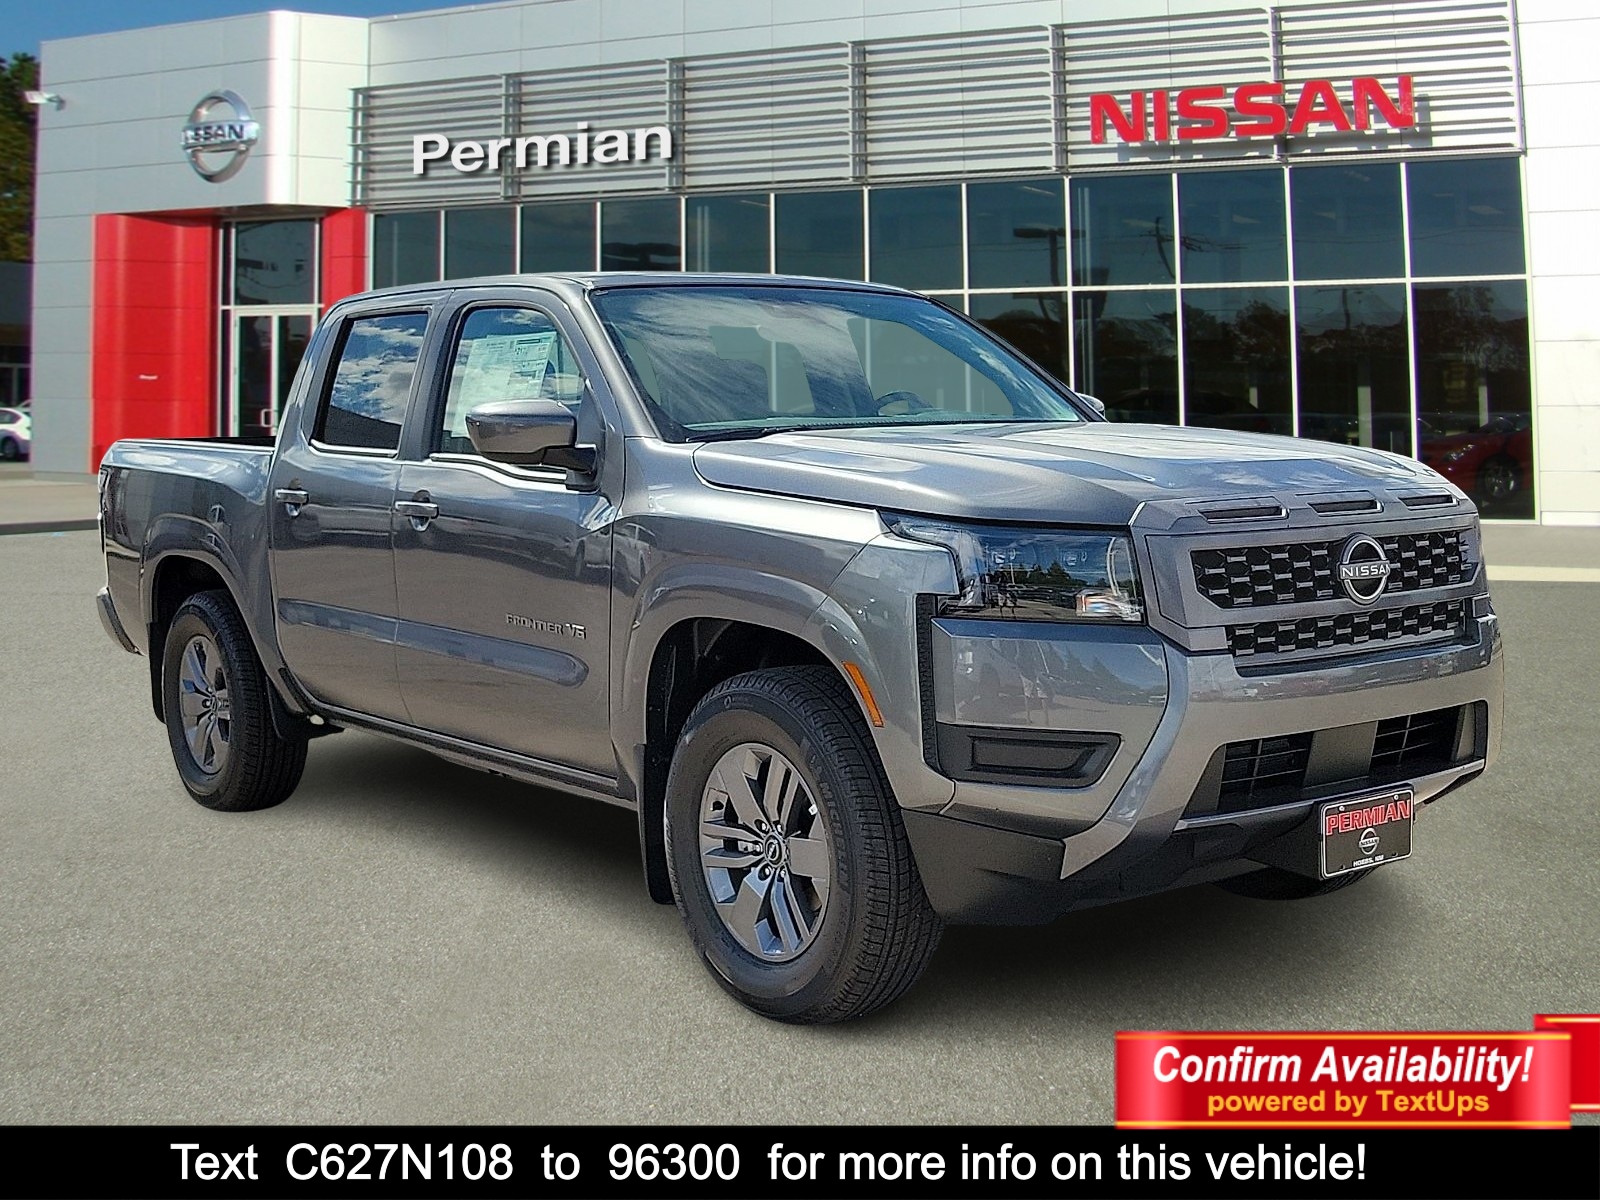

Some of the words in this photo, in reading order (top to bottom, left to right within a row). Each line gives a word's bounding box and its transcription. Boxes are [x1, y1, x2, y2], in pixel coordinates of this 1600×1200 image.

[1089, 75, 1415, 145] NISSAN
[182, 124, 245, 144] SSAN
[413, 121, 672, 175] Permian
[506, 613, 564, 636] FRONTIER
[565, 623, 587, 640] V6
[1325, 799, 1410, 835] PERMIAN
